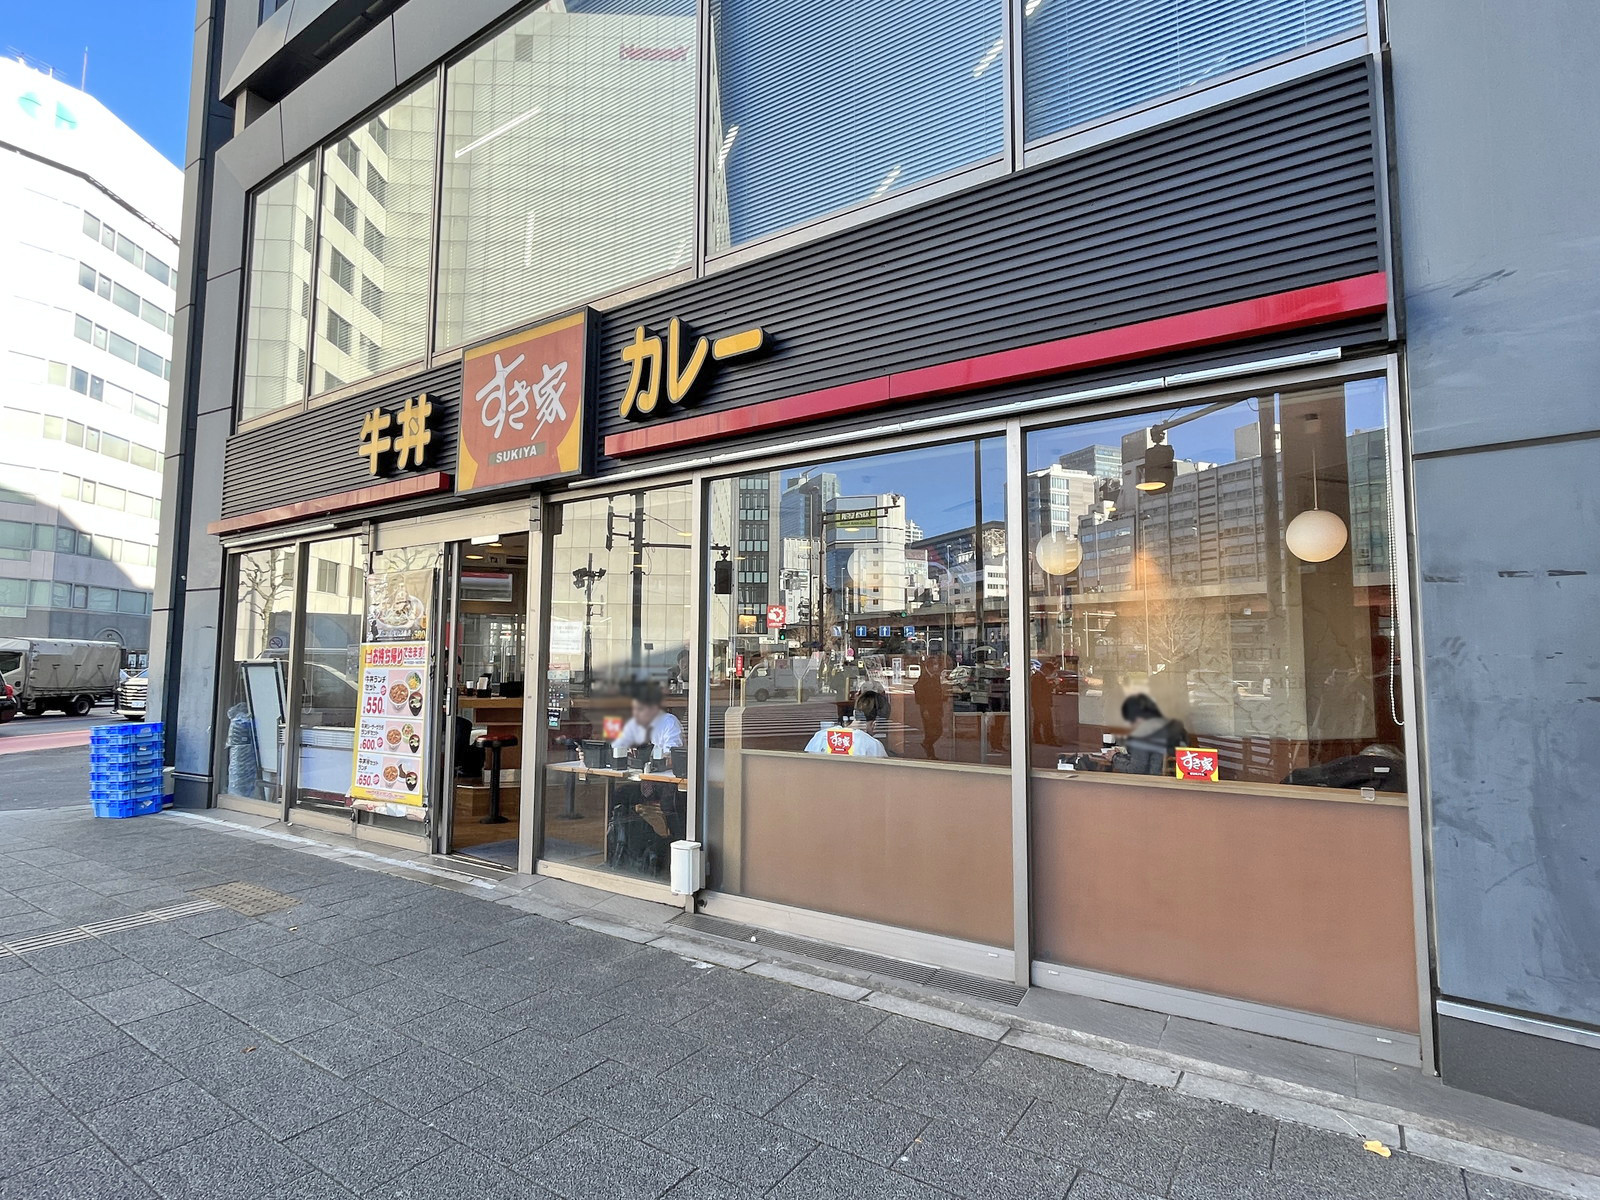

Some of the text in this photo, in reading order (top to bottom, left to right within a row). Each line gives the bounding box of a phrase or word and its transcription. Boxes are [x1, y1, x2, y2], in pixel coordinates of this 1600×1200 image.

[474, 352, 570, 441] すき家
[618, 315, 766, 420] カレー
[358, 393, 434, 476] 牛丼
[495, 444, 538, 464] SUKIYA
[1180, 750, 1214, 773] すき家
